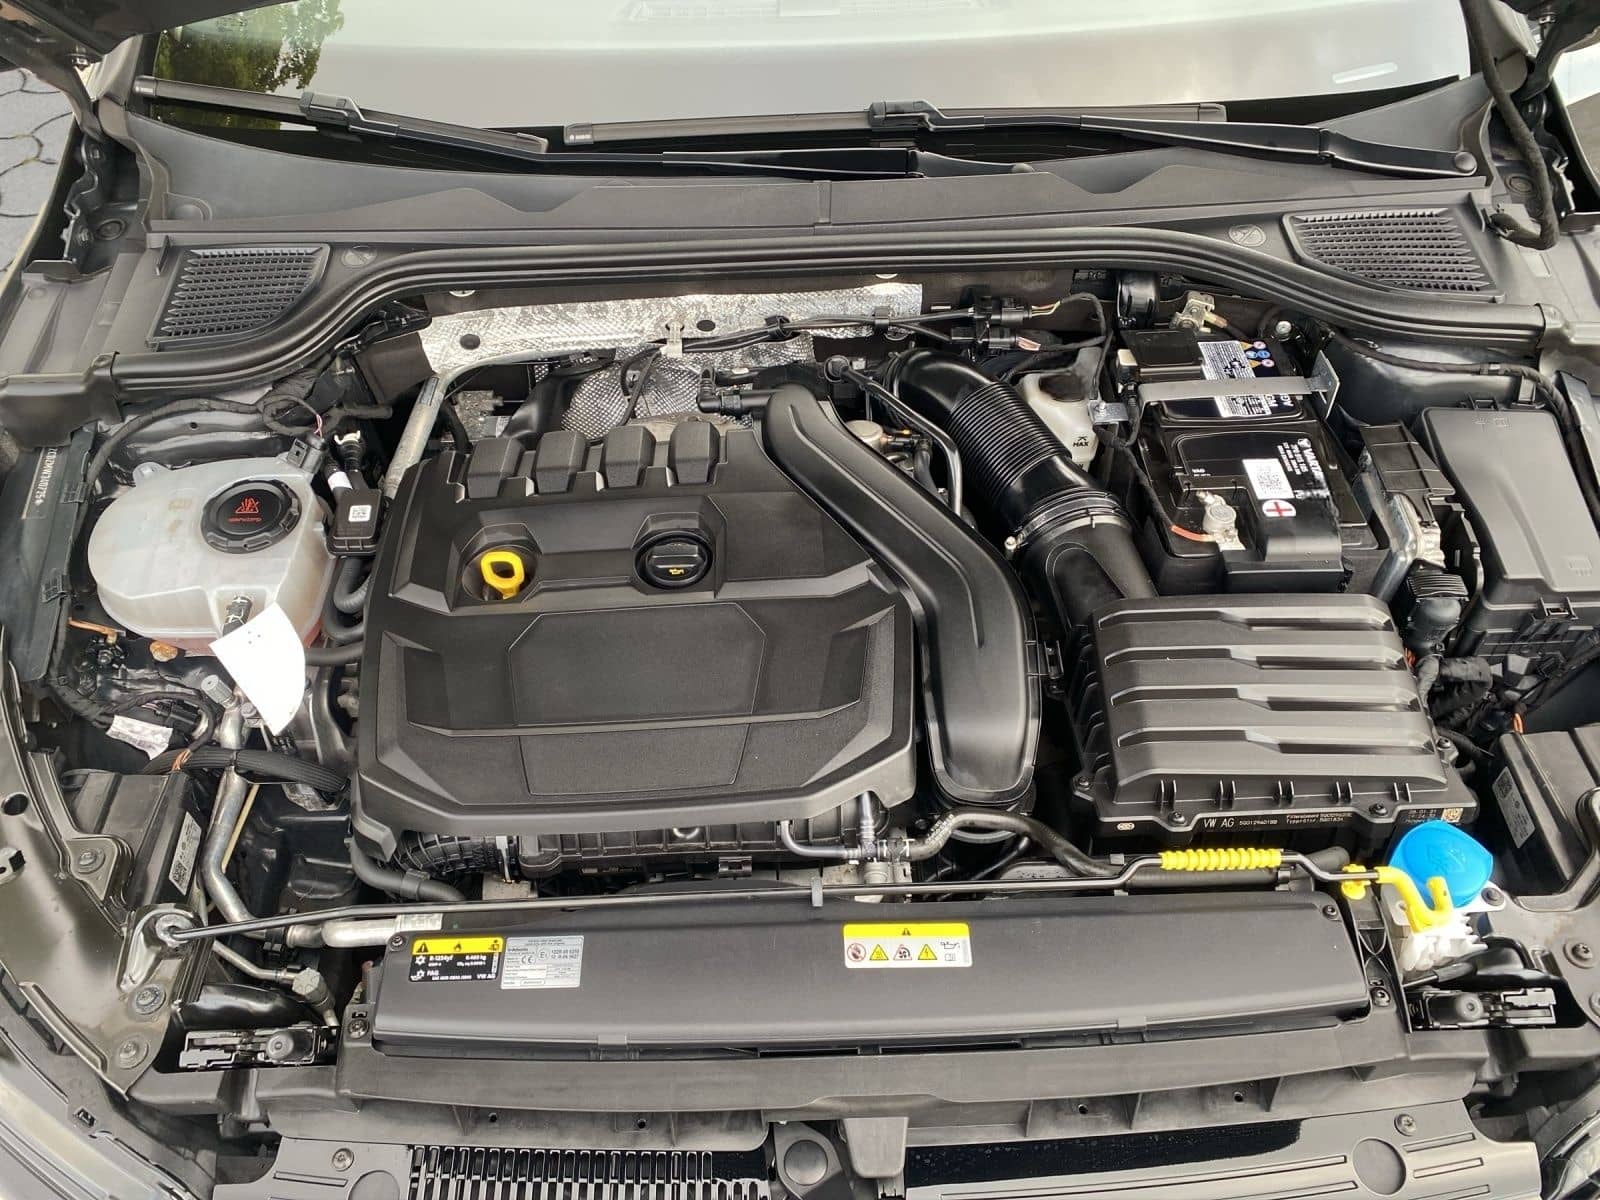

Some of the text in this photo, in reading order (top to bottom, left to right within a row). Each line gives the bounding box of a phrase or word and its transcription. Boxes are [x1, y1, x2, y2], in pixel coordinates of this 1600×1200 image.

[1303, 446, 1324, 477] VARTA
[1203, 819, 1216, 828] VW
[1220, 818, 1235, 828] AG
